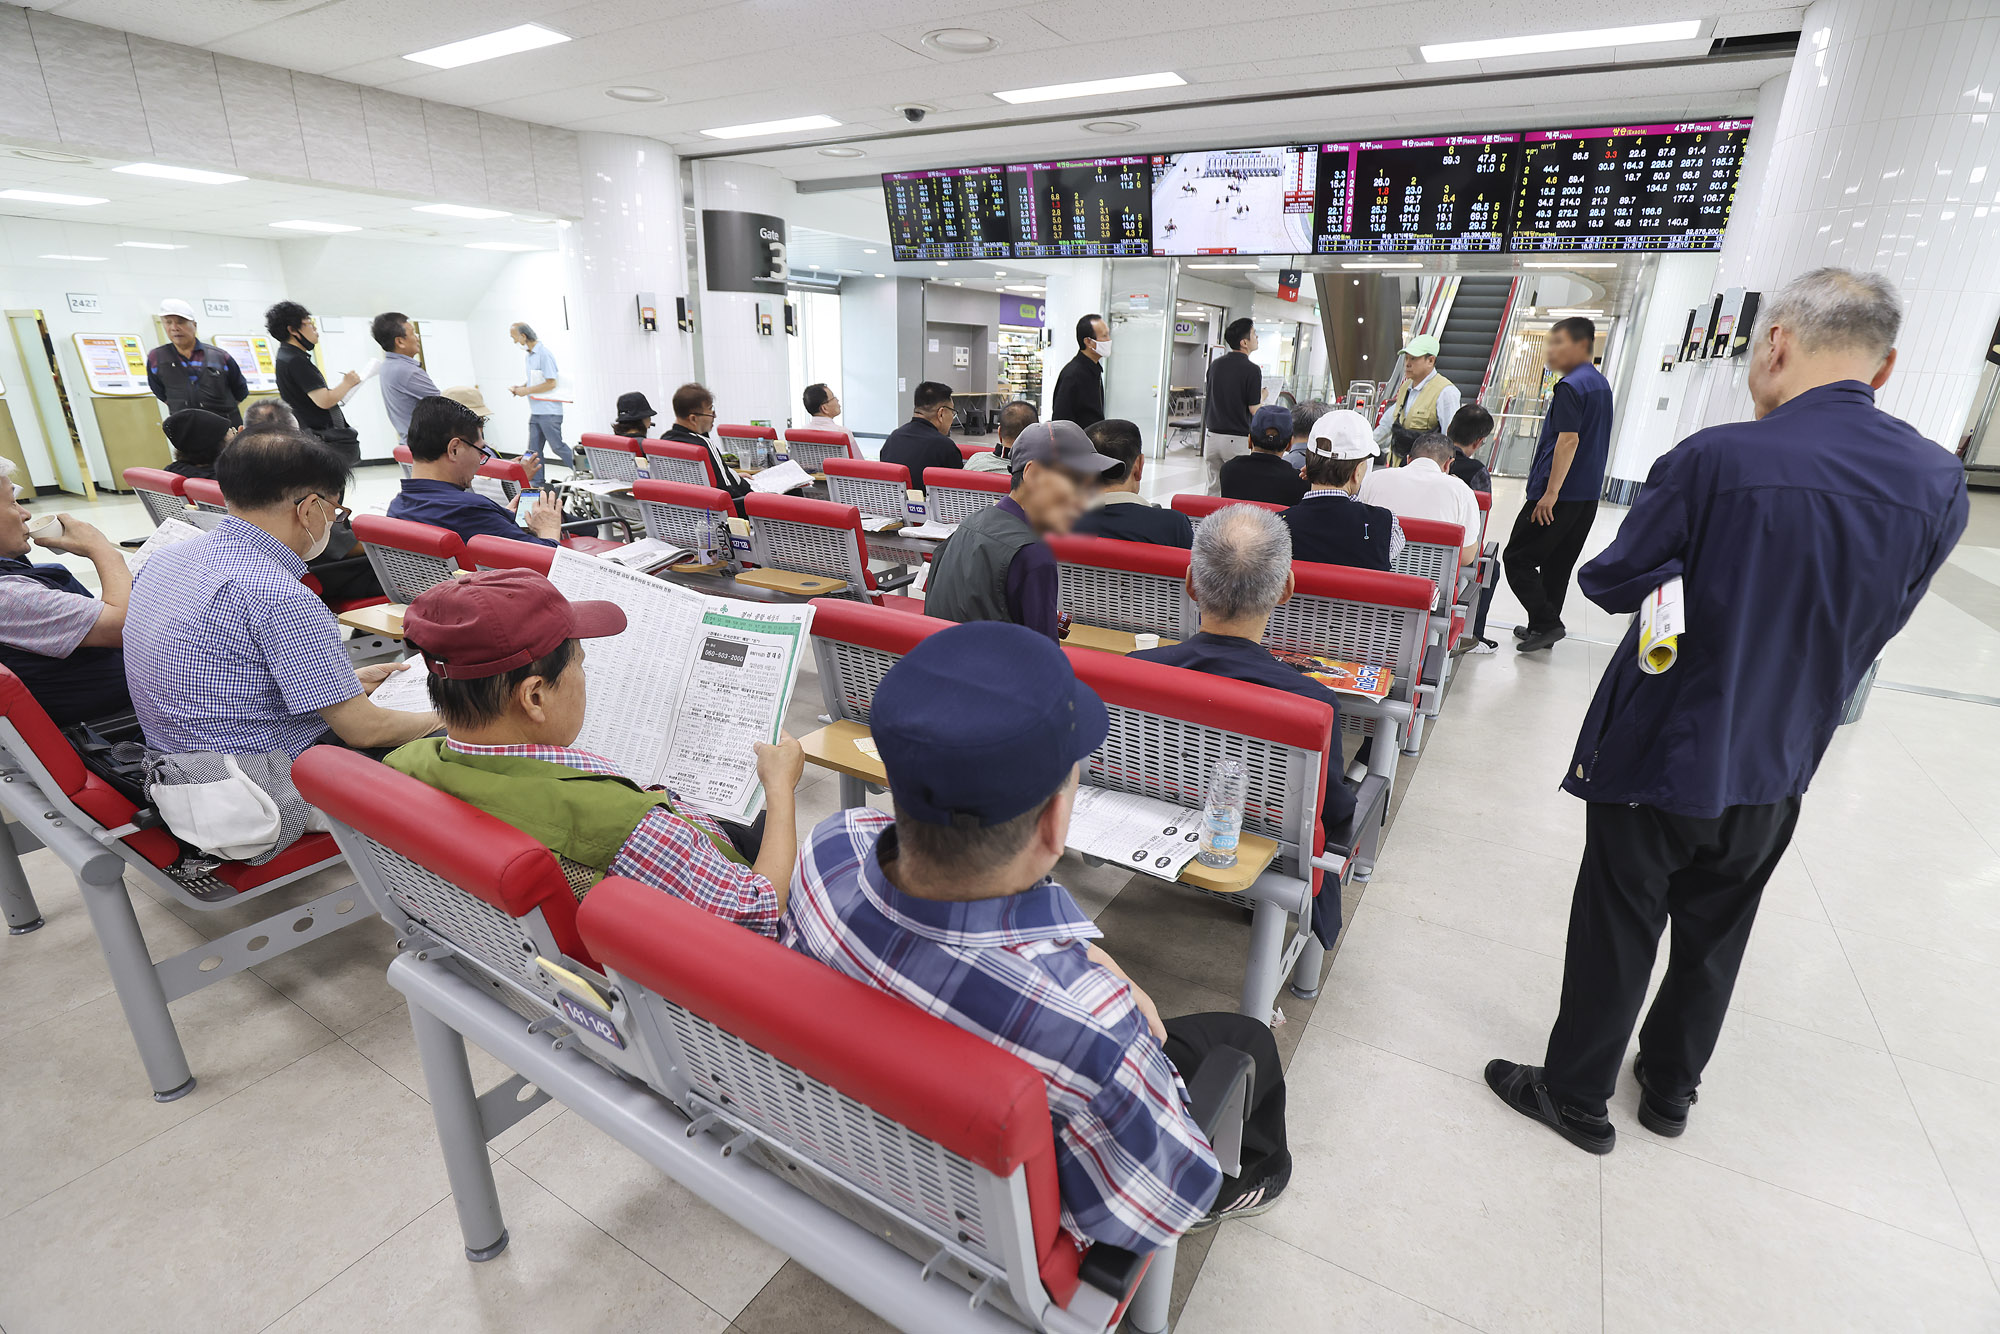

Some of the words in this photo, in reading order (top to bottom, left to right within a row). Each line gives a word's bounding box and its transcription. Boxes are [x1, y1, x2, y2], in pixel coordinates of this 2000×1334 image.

[1636, 137, 1641, 145] 4
[1666, 136, 1671, 144] 5
[1449, 146, 1454, 154] 6
[1485, 144, 1490, 153] 5
[1688, 146, 1706, 155] 91.4
[1719, 145, 1736, 154] 37.1
[1443, 156, 1460, 165] 59.3
[1478, 154, 1496, 163] 47.8
[1502, 154, 1507, 162] 7
[1543, 165, 1559, 173] 44.4
[1598, 163, 1615, 171] 30.9
[1712, 157, 1734, 166] 195.2
[1477, 164, 1494, 173] 81.0
[1500, 163, 1505, 172] 6
[1334, 170, 1346, 179] 3.3
[1350, 170, 1355, 178] 1
[1380, 169, 1383, 177] 1
[1523, 177, 1527, 185] 3
[1625, 173, 1641, 181] 18.7
[1653, 172, 1670, 180] 50.9
[1330, 180, 1345, 188] 15.4
[1349, 179, 1355, 187] 2
[1411, 177, 1416, 185] 2
[1676, 183, 1697, 191] 193.7
[1334, 189, 1344, 197] 1.6
[1348, 189, 1354, 197] 3
[1378, 187, 1389, 195] 1.8
[1405, 186, 1422, 194] 23.0
[1444, 185, 1449, 193] 3
[1333, 198, 1344, 206] 8.2
[1347, 198, 1353, 206] 4
[1405, 195, 1421, 204] 62.7
[1443, 194, 1455, 202] 8.4
[1478, 193, 1483, 201] 4
[1560, 198, 1580, 206] 214.0
[1592, 197, 1608, 205] 21.3
[1673, 195, 1694, 203] 177.3
[1328, 207, 1342, 215] 22.1
[1347, 206, 1352, 215] 5
[1404, 205, 1420, 213] 94.0
[1438, 204, 1453, 212] 17.1
[1471, 203, 1489, 211] 48.5
[1494, 202, 1500, 210] 5
[1558, 209, 1578, 217] 272.2
[1614, 208, 1633, 216] 132.1
[1700, 206, 1721, 214] 134.2
[1327, 216, 1343, 224] 33.7
[1346, 215, 1352, 223] 6
[1437, 213, 1452, 221] 19.1
[1493, 212, 1498, 220] 6
[1327, 224, 1342, 233] 13.3
[1345, 224, 1351, 232] 7
[1469, 221, 1486, 230] 29.5
[1492, 221, 1497, 229] 7
[760, 227, 779, 241] Gate
[769, 242, 788, 280] 3
[71, 299, 97, 308] 2427
[207, 303, 230, 312] 2428
[1176, 323, 1190, 332] CU
[565, 1002, 589, 1026] 141
[588, 1016, 616, 1042] 142
